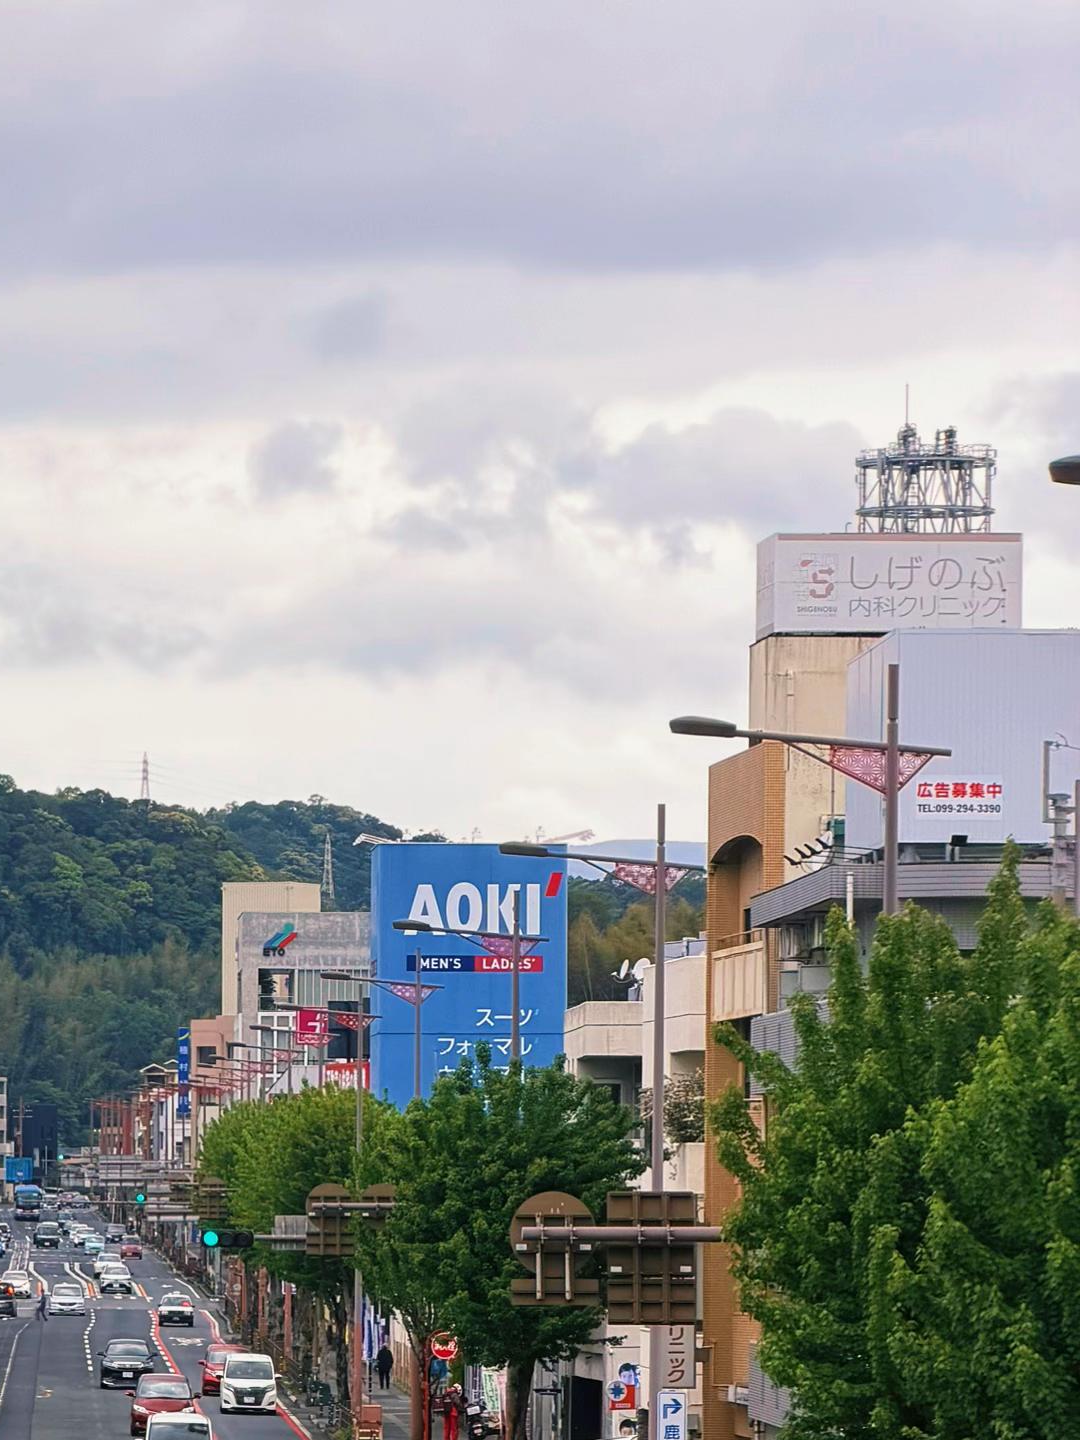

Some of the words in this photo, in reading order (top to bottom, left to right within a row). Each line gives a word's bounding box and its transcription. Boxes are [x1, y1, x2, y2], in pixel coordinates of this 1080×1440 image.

[850, 555, 1006, 591] しげのぶ
[849, 595, 1002, 618] 内科クリニック
[917, 782, 1003, 799] 広告募集中
[403, 881, 541, 937] AOKI
[420, 957, 462, 969] MEN'S
[475, 1008, 533, 1027] スーツ
